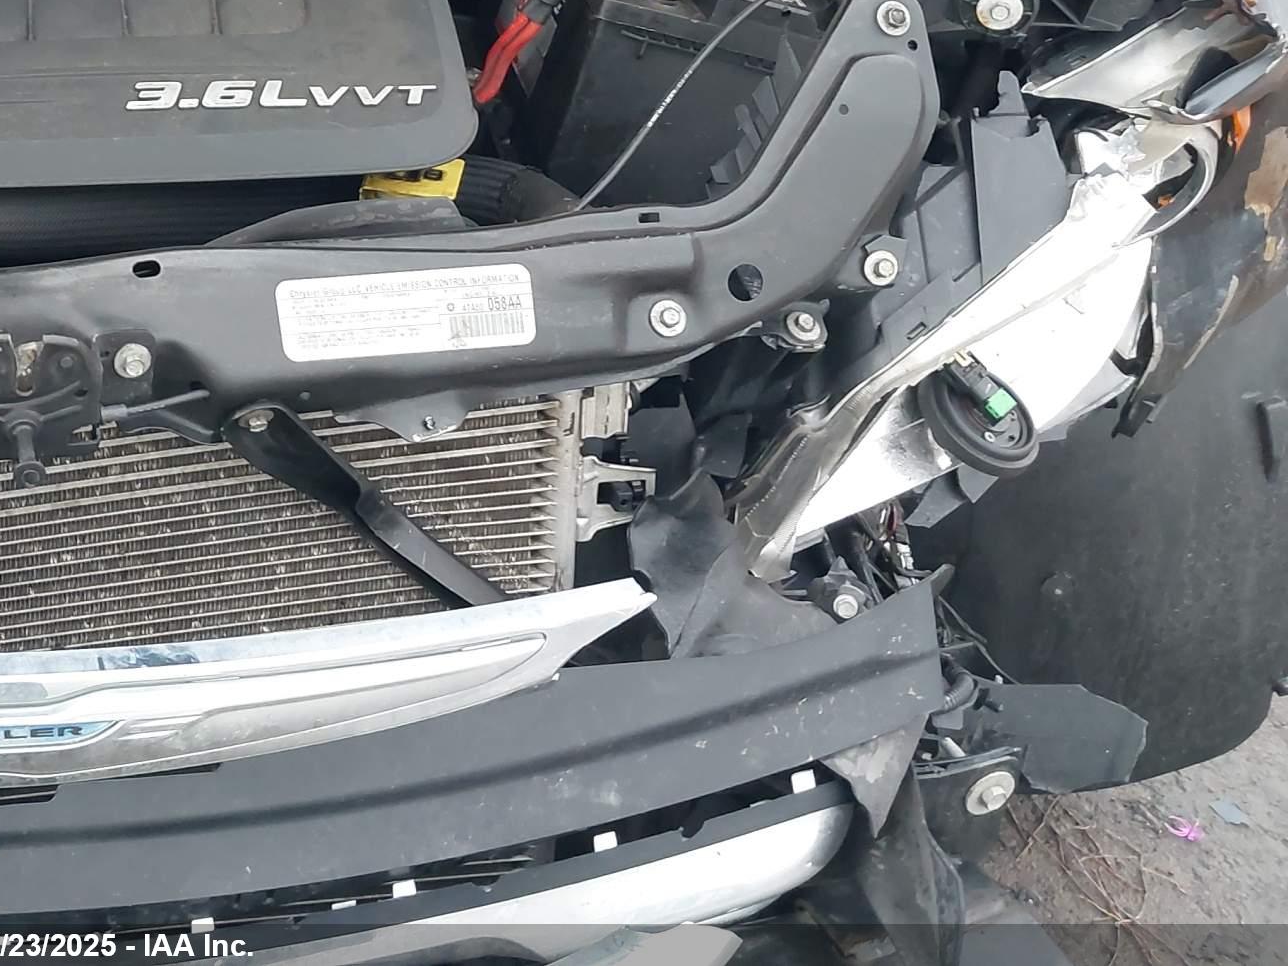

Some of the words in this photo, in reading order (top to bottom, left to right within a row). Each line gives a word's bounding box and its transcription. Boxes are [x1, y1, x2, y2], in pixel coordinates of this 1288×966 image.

[396, 280, 433, 293] EMISSION
[434, 278, 467, 290] CONTROL
[469, 274, 520, 287] INFORMATION
[487, 296, 523, 312] 058AA
